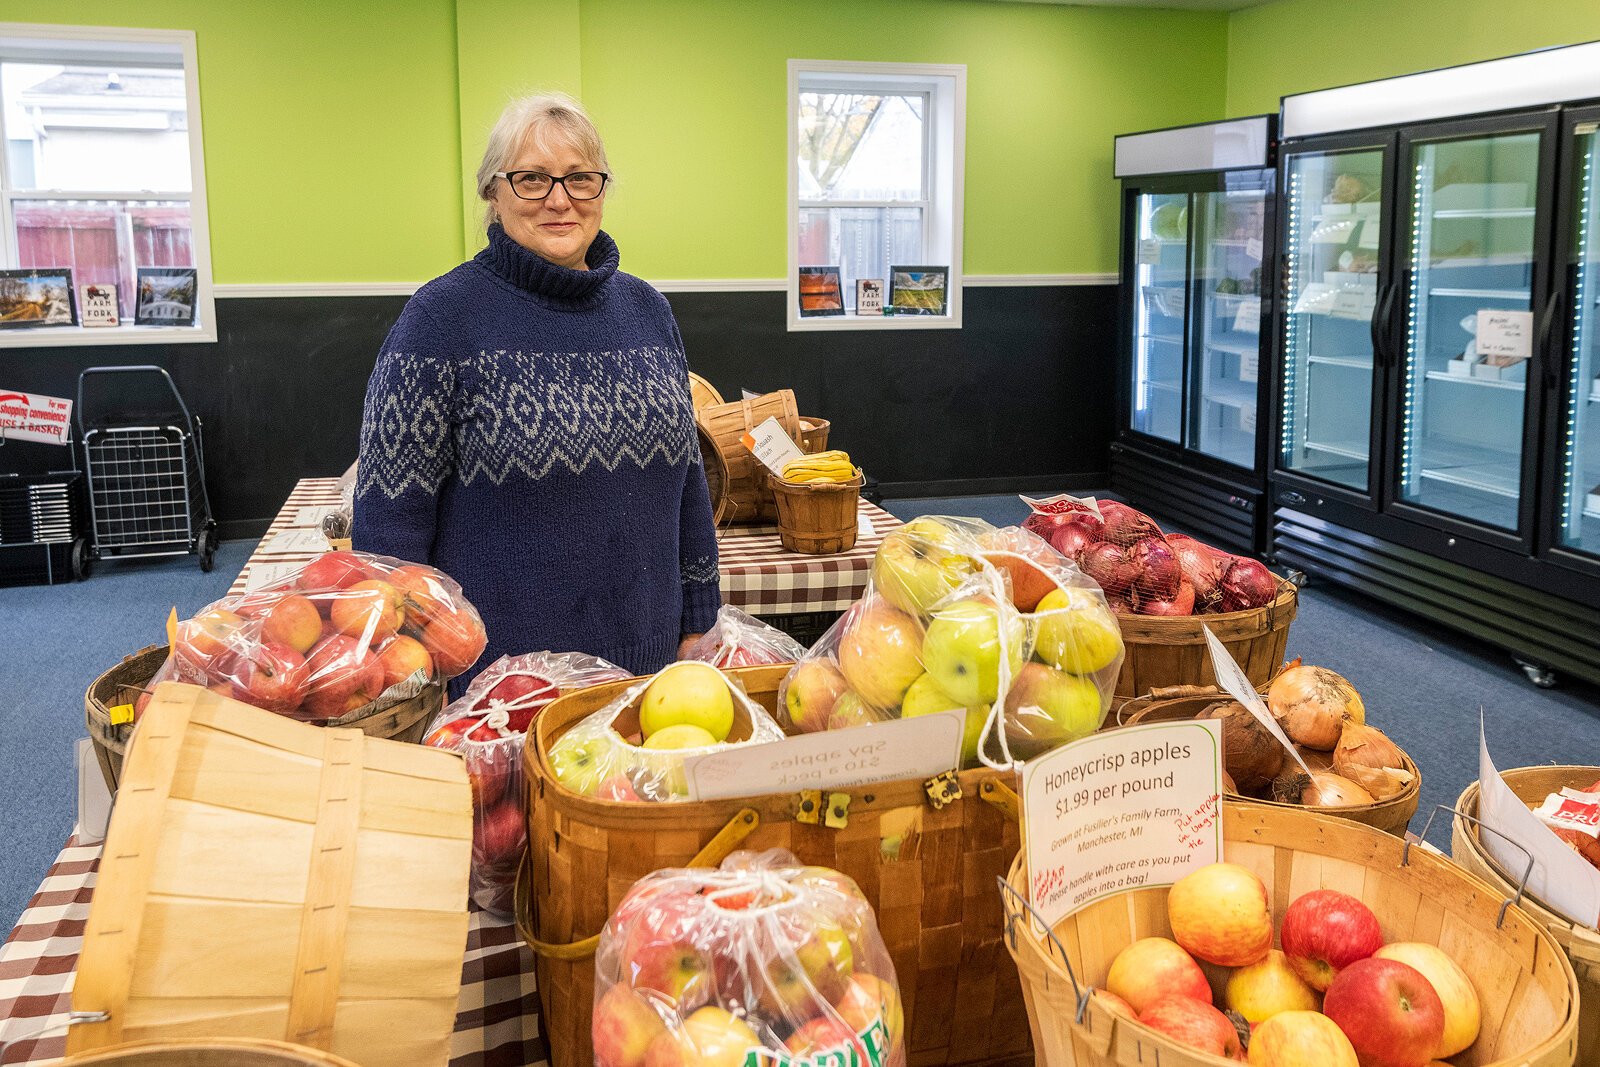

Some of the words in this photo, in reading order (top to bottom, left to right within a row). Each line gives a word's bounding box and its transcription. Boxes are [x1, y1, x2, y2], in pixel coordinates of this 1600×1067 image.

[0, 403, 28, 419] shopping
[29, 409, 66, 422] convenience
[0, 419, 17, 429] USE
[19, 421, 25, 430] A
[28, 422, 63, 435] BASKET
[1045, 754, 1125, 794] Honeycrisp
[1131, 742, 1191, 767] apples
[1056, 789, 1089, 820] $1.99
[1094, 785, 1117, 806] per
[1122, 771, 1174, 797] pound
[1051, 833, 1073, 852] Grown
[1074, 828, 1082, 840] at
[1120, 809, 1151, 823] Family
[1154, 807, 1183, 818] Farm,
[1174, 814, 1193, 832] Put
[1077, 829, 1127, 854] Manchester,
[1129, 826, 1143, 838] MI
[1178, 834, 1190, 843] in
[1188, 839, 1204, 849] tie
[1049, 885, 1068, 905] Please
[1069, 871, 1094, 891] handle
[1095, 862, 1114, 878] with
[1115, 860, 1136, 872] care
[1138, 857, 1150, 867] as
[1152, 855, 1170, 869] you
[1173, 854, 1191, 866] put
[1073, 886, 1097, 904] apples
[1099, 879, 1116, 892] into
[1117, 878, 1124, 887] a
[1126, 871, 1149, 886] bag!
